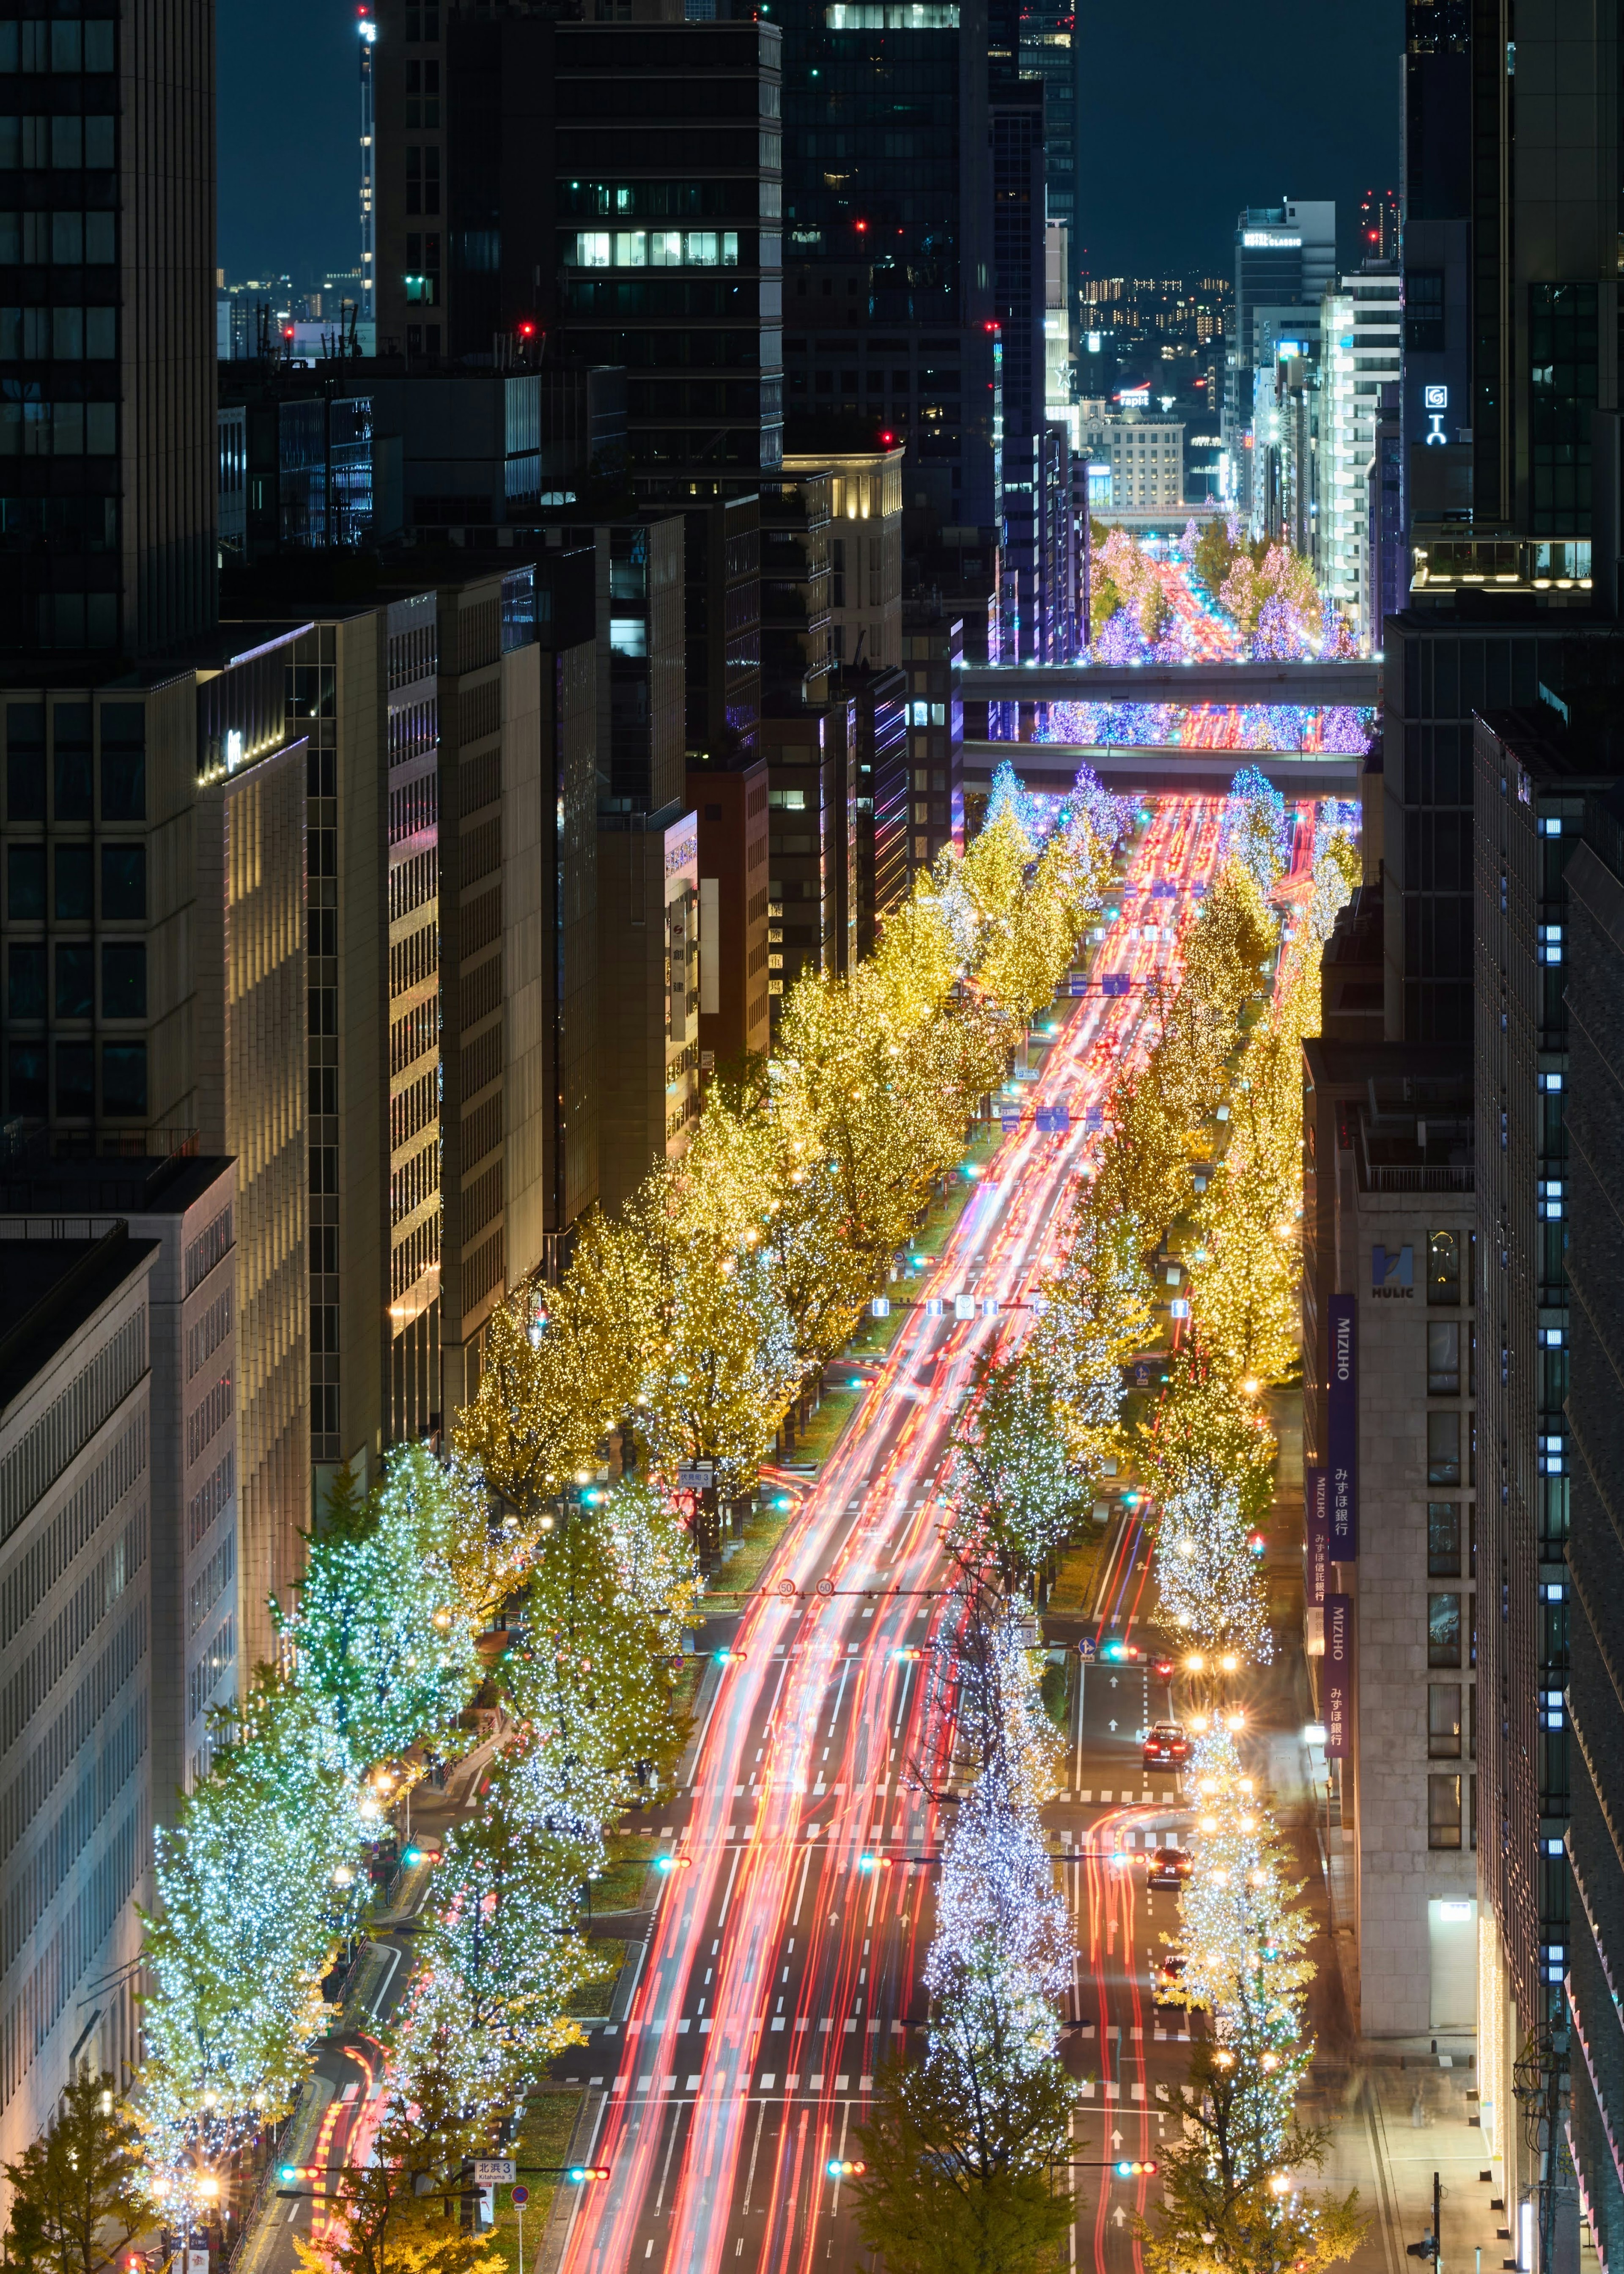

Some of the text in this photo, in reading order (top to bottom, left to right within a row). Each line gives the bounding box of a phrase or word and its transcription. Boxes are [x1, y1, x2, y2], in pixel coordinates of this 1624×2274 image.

[673, 950, 684, 992] 創建
[771, 904, 781, 993] 保険市場
[1372, 1287, 1413, 1298] HULIC
[1337, 1318, 1350, 1381] MIZUHO
[1317, 1477, 1325, 1518] MIZUHO
[1336, 1468, 1348, 1536] みずほ銀行
[781, 1583, 792, 1592] 50
[820, 1583, 831, 1592] 60
[1315, 1534, 1325, 1601] みずほ信託銀行
[1333, 1607, 1344, 1660] MIZUHO
[1331, 1688, 1342, 1746] みずほ銀行
